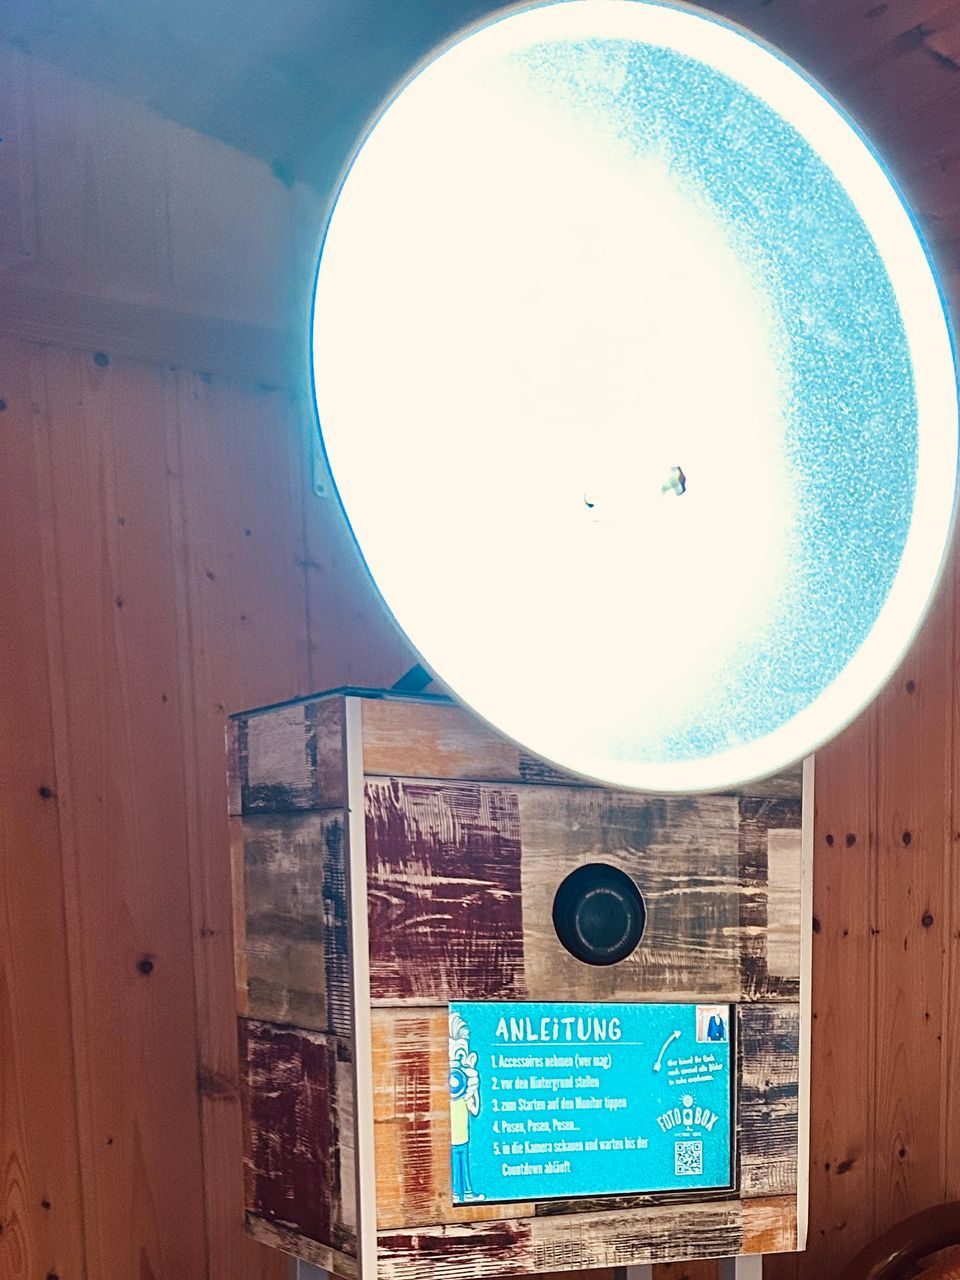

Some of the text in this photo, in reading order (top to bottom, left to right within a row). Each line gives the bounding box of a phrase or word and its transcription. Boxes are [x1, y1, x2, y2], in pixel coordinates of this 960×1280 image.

[545, 1055, 573, 1068] nehmen
[575, 1053, 591, 1068] (wer
[593, 1053, 612, 1070] mag)
[501, 1079, 513, 1089] vor
[515, 1077, 528, 1089] den
[530, 1076, 573, 1092] Hintergrund
[575, 1076, 600, 1088] stellen
[501, 1101, 516, 1111] zum
[518, 1098, 546, 1111] Starten
[547, 1097, 559, 1110] auf
[561, 1097, 574, 1110] den
[575, 1096, 603, 1109] Monitor
[604, 1096, 627, 1111] tippen
[502, 1120, 526, 1134] Posen,
[528, 1119, 551, 1133] Posen,
[656, 1107, 719, 1133] FOTO BOX
[511, 1141, 523, 1154] die
[524, 1141, 552, 1154] Kamera
[554, 1139, 583, 1152] schauen
[585, 1138, 598, 1151] und
[599, 1138, 623, 1150] warten
[625, 1136, 635, 1149] bis
[637, 1136, 648, 1149] der
[502, 1161, 571, 1176] Countdown abläuft
